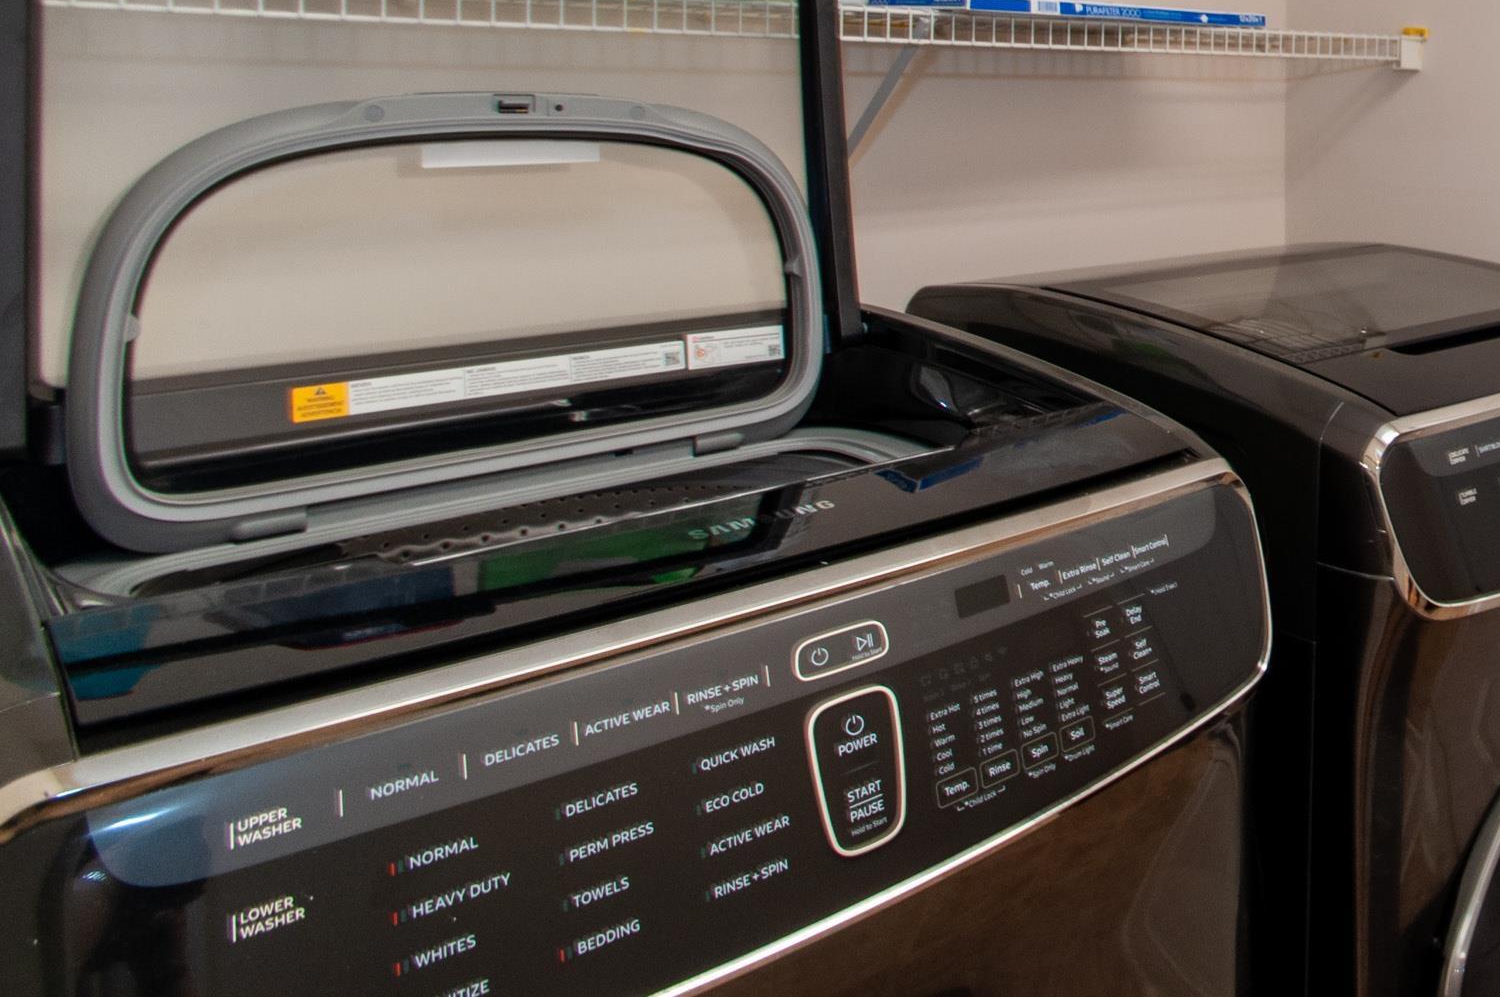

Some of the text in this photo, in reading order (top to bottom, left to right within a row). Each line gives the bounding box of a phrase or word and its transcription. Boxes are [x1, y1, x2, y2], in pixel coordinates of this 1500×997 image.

[688, 500, 835, 539] SAMUNG
[1101, 555, 1114, 566] Self
[1062, 563, 1097, 580] Extra Rinse
[1125, 605, 1142, 617] Delay
[1095, 619, 1107, 628] Pre
[1130, 615, 1142, 625] End
[1095, 627, 1111, 639] Soak
[1135, 638, 1147, 649] Self
[1052, 655, 1084, 672] Extra Heavy
[1098, 652, 1119, 665] Steam
[1014, 670, 1044, 687] Extra High
[1055, 672, 1073, 683] Heavy
[1138, 671, 1157, 684] Smart
[687, 686, 722, 706] RINSE
[731, 675, 759, 692] SPIN
[1016, 688, 1032, 699] High
[1057, 682, 1079, 696] Normal
[1105, 686, 1124, 699] Super
[1139, 679, 1160, 694] Control
[727, 697, 745, 709] Only
[979, 689, 998, 701] times
[1106, 695, 1126, 710] Speed
[981, 702, 1000, 714] times
[1019, 698, 1044, 712] Medium
[1060, 697, 1075, 710] Light
[585, 701, 671, 737] ACTIVE WEAR
[930, 703, 961, 721] Extra Hot
[1061, 704, 1091, 722] Extra Light
[932, 723, 946, 734] Hot
[983, 715, 1002, 728] times
[1021, 715, 1035, 726] Low
[985, 728, 1005, 741] times
[1023, 723, 1048, 739] No Spin
[1070, 726, 1086, 740] Soil
[838, 734, 878, 756] POWER
[934, 734, 956, 747] Warm
[484, 734, 560, 767] DELICATES
[701, 736, 776, 772] QUICK WASH
[937, 749, 953, 762] Cool
[987, 743, 1003, 755] time
[1031, 745, 1049, 759] Spin
[939, 762, 955, 775] Cold
[988, 762, 1012, 778] Rinse
[370, 770, 439, 800] NORMAL
[847, 779, 882, 803] START
[944, 781, 970, 797] Temp.
[565, 783, 638, 817] DELICATES
[705, 782, 765, 813] ECO COLD
[983, 791, 997, 801] Lock
[850, 799, 885, 823] PAUSE
[237, 807, 288, 832] UPPER
[851, 823, 866, 836] Hold
[872, 816, 888, 829] Start
[238, 817, 302, 847] WASHER
[710, 815, 790, 856] ACTIVE WEAR
[570, 822, 654, 862] PERM PRESS
[409, 837, 479, 870] NORMAL
[714, 874, 751, 899] RINSE
[760, 859, 789, 879] SPIN
[412, 872, 511, 919] HEAVY DUTY
[573, 877, 630, 908] TOWELS
[240, 896, 295, 924] LOWER
[240, 907, 305, 939] WASHER
[577, 919, 641, 955] BEDDING
[415, 934, 477, 968] WHITES
